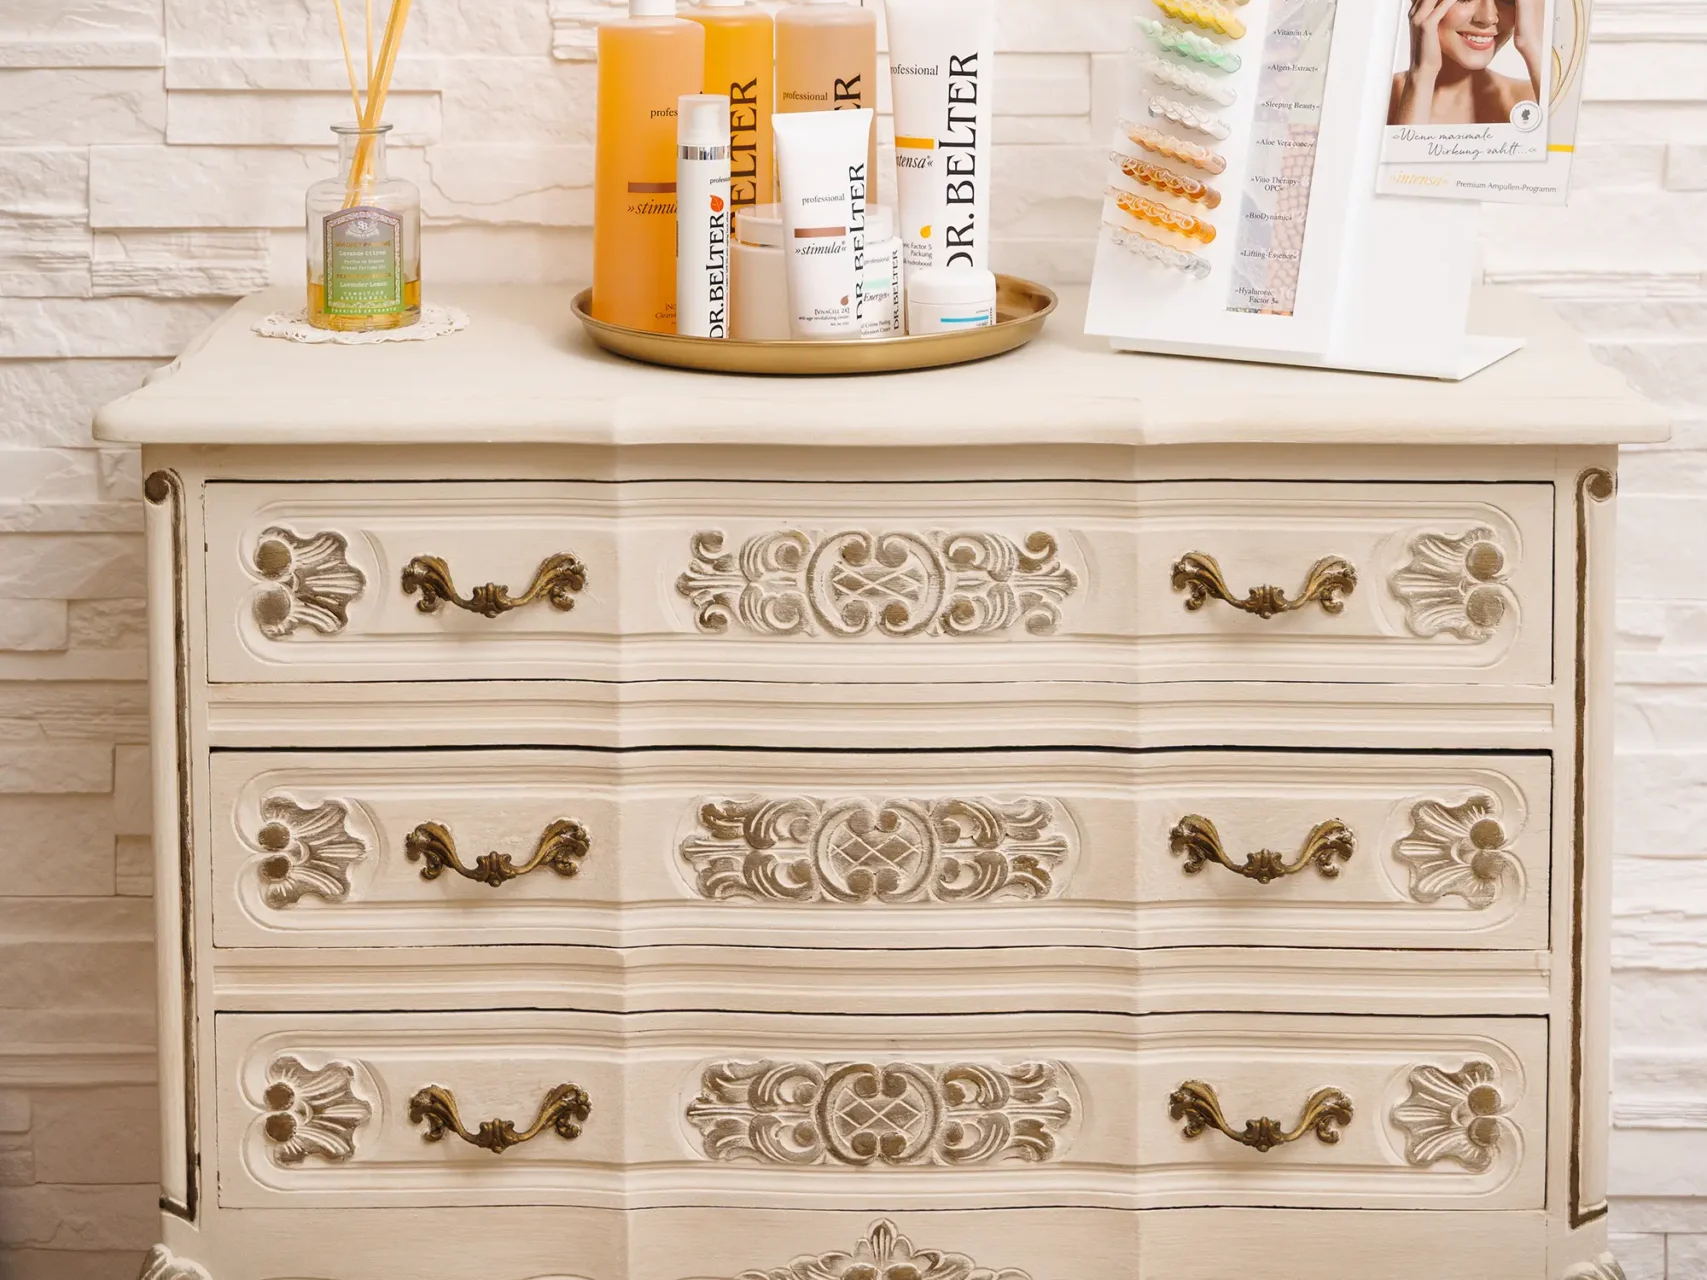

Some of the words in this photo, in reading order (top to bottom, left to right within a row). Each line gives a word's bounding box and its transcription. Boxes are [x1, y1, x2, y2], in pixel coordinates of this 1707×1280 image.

[890, 63, 939, 75] rofessional
[782, 90, 829, 101] professional
[650, 107, 678, 119] profes
[1438, 127, 1494, 141] maximale
[1427, 142, 1484, 160] Wirkung
[1456, 180, 1486, 189] Premium
[1488, 182, 1557, 194] Ampullen-Programm
[801, 193, 846, 206] professional
[910, 249, 933, 259] Packung
